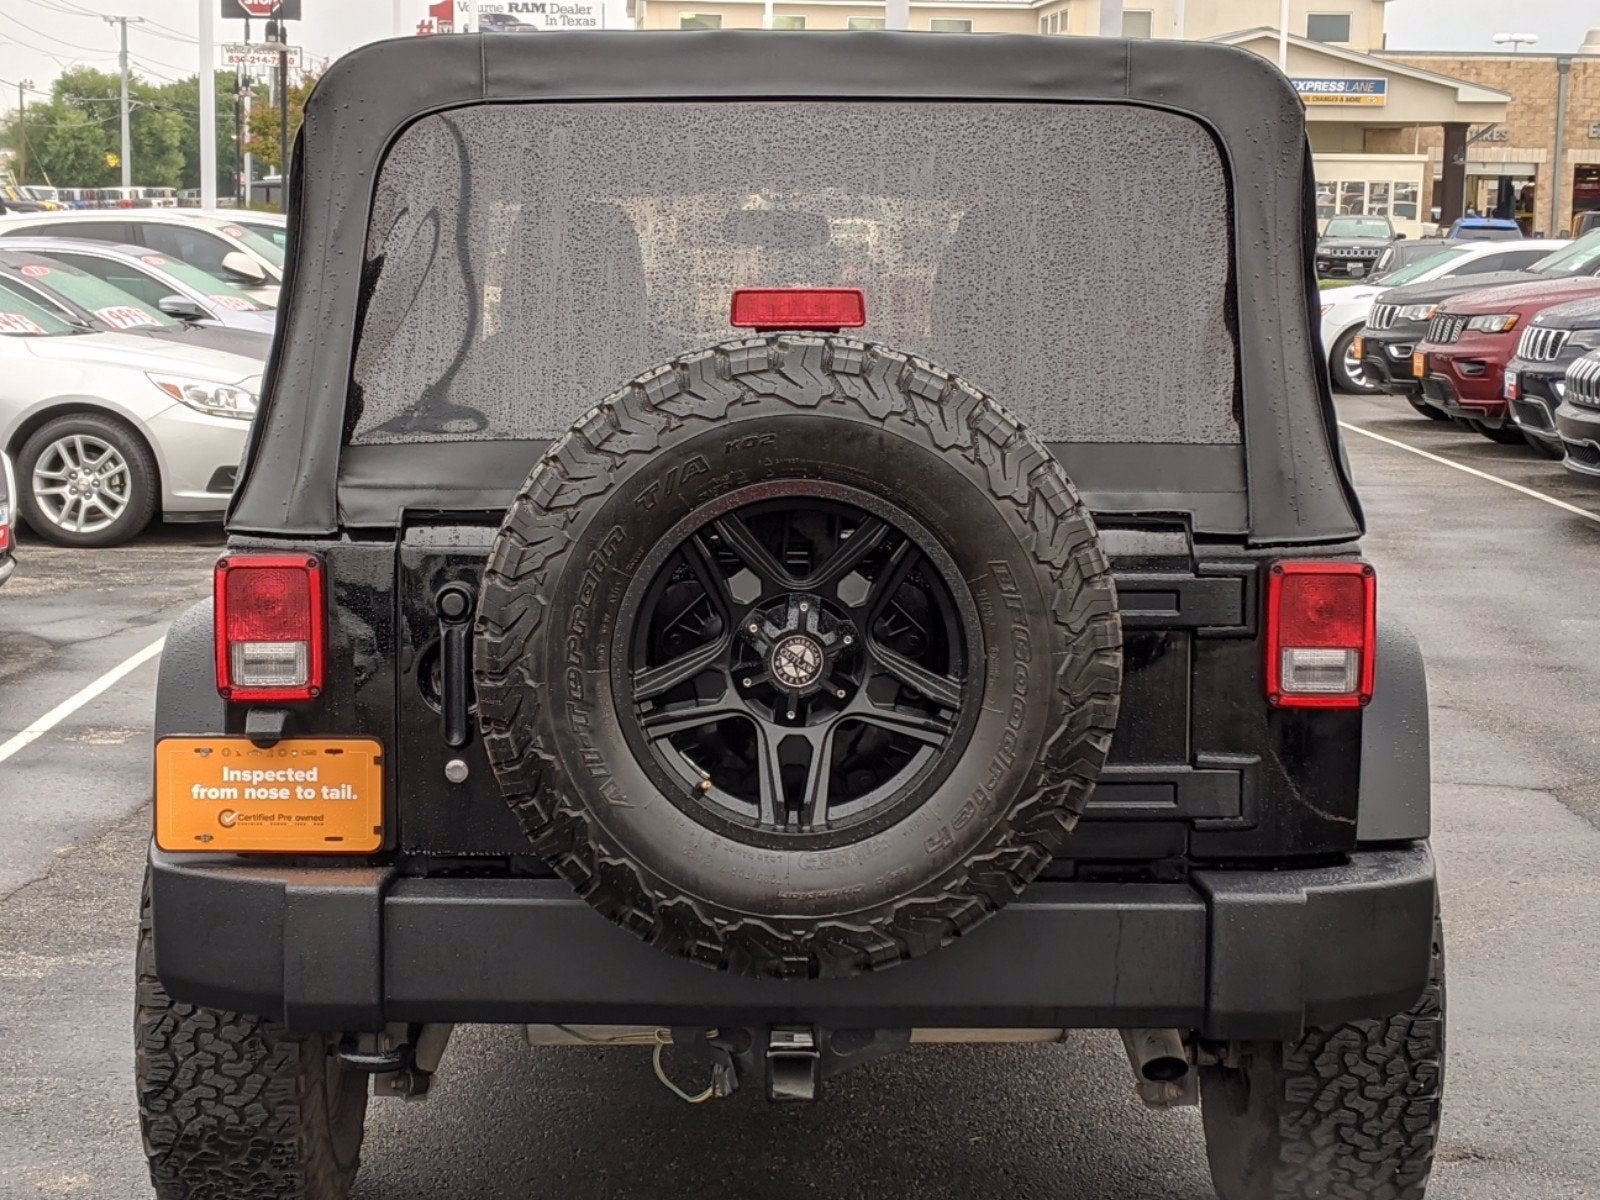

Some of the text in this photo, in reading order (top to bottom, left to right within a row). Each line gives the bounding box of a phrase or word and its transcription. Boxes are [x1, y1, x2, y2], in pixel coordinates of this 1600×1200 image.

[458, 2, 593, 14] Voume RAM Dealer
[545, 15, 597, 26] In Texas
[634, 454, 712, 512] T/A
[780, 648, 815, 673] OUTLAW
[922, 560, 1032, 855] BFGoodrich
[222, 767, 318, 785] Inspected
[191, 784, 358, 800] from nose to tail.
[238, 813, 275, 822] Certified
